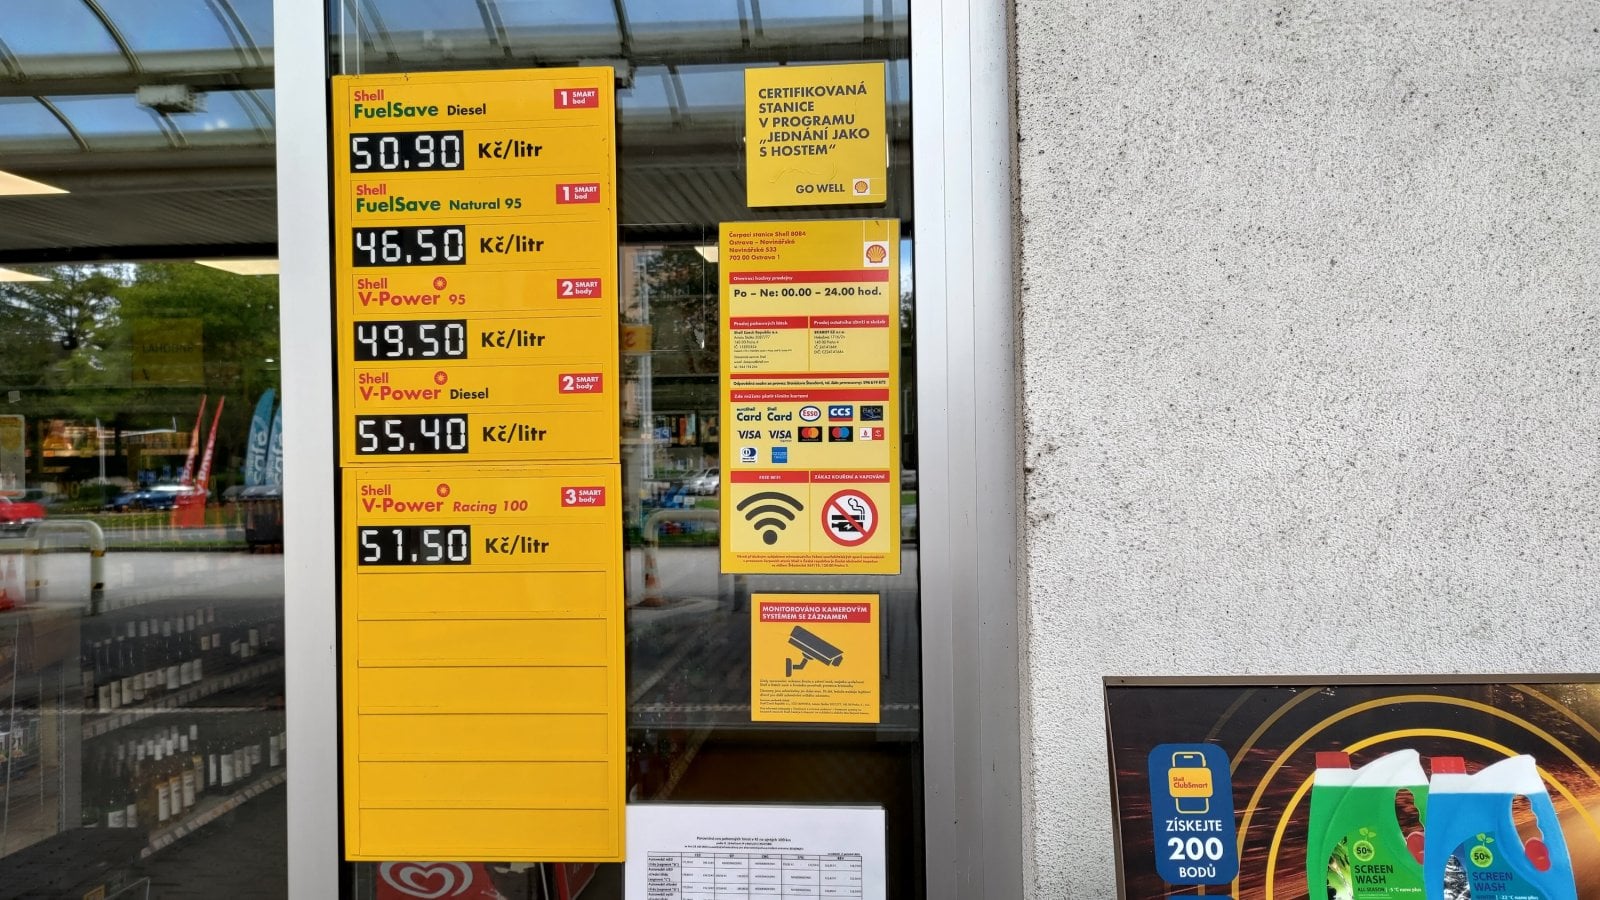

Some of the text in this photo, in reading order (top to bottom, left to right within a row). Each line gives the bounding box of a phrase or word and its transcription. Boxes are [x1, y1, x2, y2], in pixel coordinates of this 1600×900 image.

[354, 90, 384, 101] Shell
[758, 81, 868, 99] CERTIFIKOVANÁ
[560, 91, 568, 106] 1
[354, 102, 486, 118] FuelSave Diesel
[758, 102, 814, 114] STANICE
[758, 114, 855, 128] V PROGRAMU
[832, 128, 870, 140] JAKO
[478, 140, 542, 159] Kč/litr
[760, 146, 768, 157] S
[356, 184, 386, 195] Shell
[562, 186, 570, 200] 1
[796, 184, 846, 194] GO WELL
[356, 196, 522, 212] FuelSave Natural 95
[480, 234, 544, 254] Kč/litr
[358, 278, 388, 290] Shell
[562, 280, 573, 296] 2
[576, 288, 592, 296] body
[734, 290, 747, 298] Po
[760, 289, 778, 297] Ne:
[781, 288, 812, 297] 00.00
[824, 288, 854, 296] 24.00
[858, 287, 881, 296] hod.
[358, 291, 466, 306] V-Power 95
[482, 328, 546, 348] Kč/litr
[358, 372, 388, 384] Shell
[563, 376, 574, 391] 2
[576, 382, 594, 392] body
[360, 386, 489, 401] V-Power Diesel
[737, 412, 761, 421] Card
[767, 412, 792, 421] Card
[830, 408, 850, 416] CCS
[482, 423, 547, 442] Kč/litr
[737, 430, 761, 439] VISA
[768, 430, 792, 439] VISA
[361, 484, 392, 496] Shell
[565, 489, 576, 504] 3
[578, 496, 596, 504] body
[362, 498, 528, 514] V-Power Racing 100
[485, 536, 549, 554] Kč/litr
[1166, 817, 1222, 832] ZÍSKEJTE
[1168, 837, 1224, 860] 200
[1179, 863, 1216, 878] BODŮ
[1354, 865, 1394, 874] SCREEN
[1356, 875, 1386, 884] WASH
[1472, 872, 1513, 880] SCREEN
[1474, 883, 1505, 891] WASH
